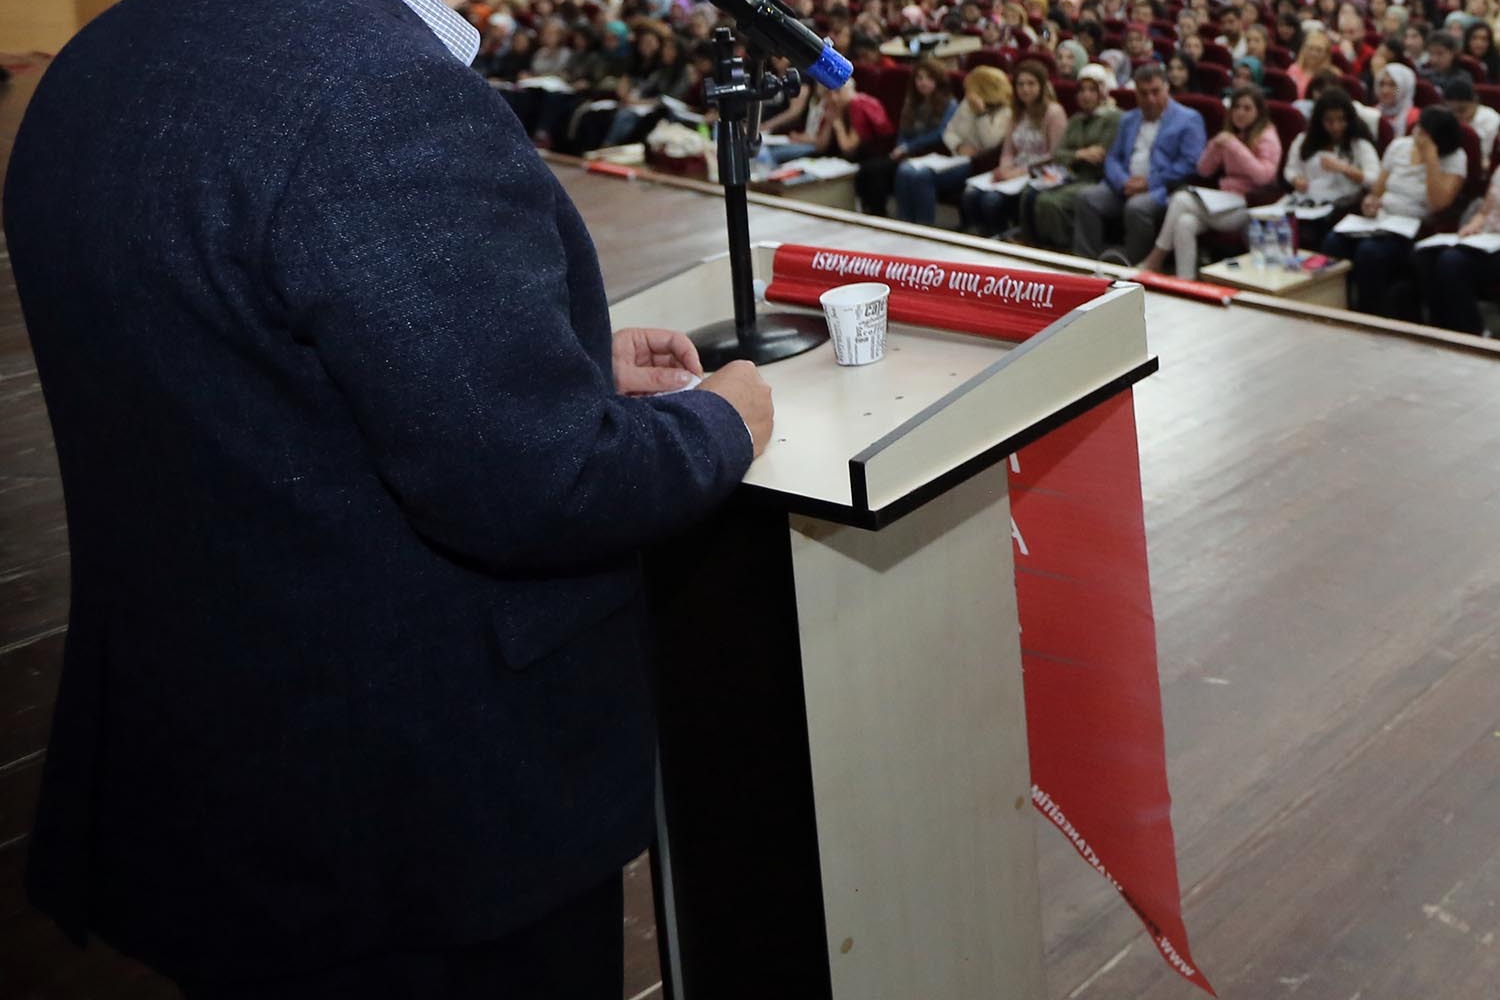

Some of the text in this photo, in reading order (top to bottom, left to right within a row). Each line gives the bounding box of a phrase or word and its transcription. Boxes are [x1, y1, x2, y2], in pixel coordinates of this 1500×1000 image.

[811, 251, 1055, 308] Türkiye'nin eğitim markası
